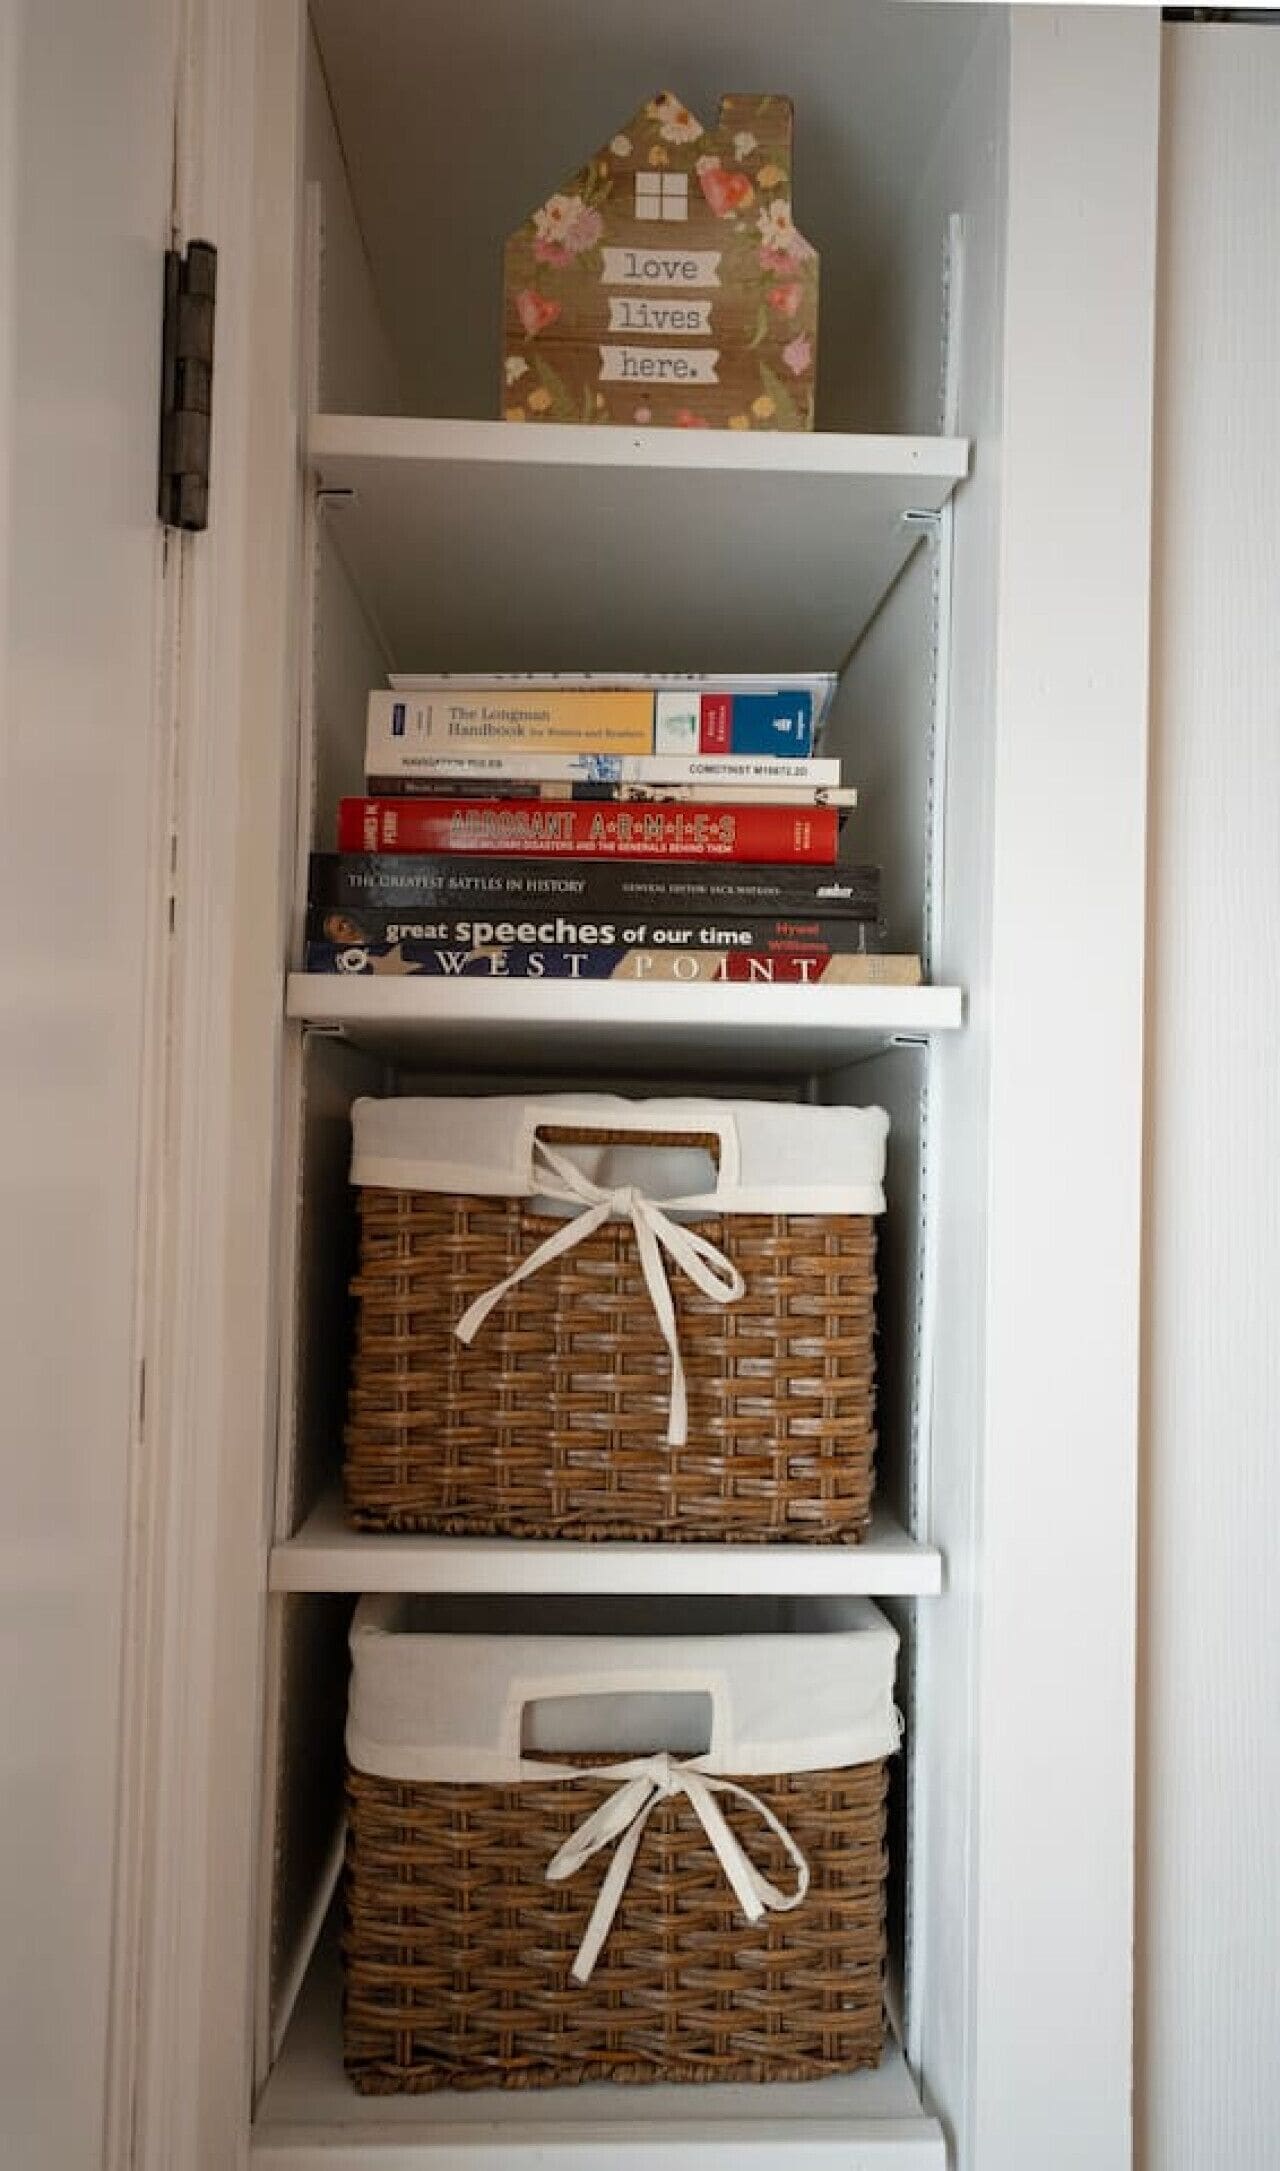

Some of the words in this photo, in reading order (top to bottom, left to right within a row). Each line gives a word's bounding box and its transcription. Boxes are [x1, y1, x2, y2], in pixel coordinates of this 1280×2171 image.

[623, 252, 699, 280] love
[619, 302, 701, 329] lives
[620, 350, 699, 379] here.
[449, 706, 477, 721] The
[482, 706, 551, 723] Longman
[449, 722, 525, 737] Handbook
[450, 809, 578, 840] ARROGANT
[348, 873, 374, 889] THE
[378, 873, 444, 890] GREATEST
[449, 875, 502, 891] BATTLES
[506, 879, 523, 892] IN
[526, 878, 586, 894] HISTORY
[385, 923, 449, 944] great
[455, 917, 616, 949] speeches
[622, 925, 647, 945] of
[652, 929, 693, 945] our
[700, 926, 753, 945] time
[434, 950, 590, 979] WEST
[633, 955, 818, 982] POINT
